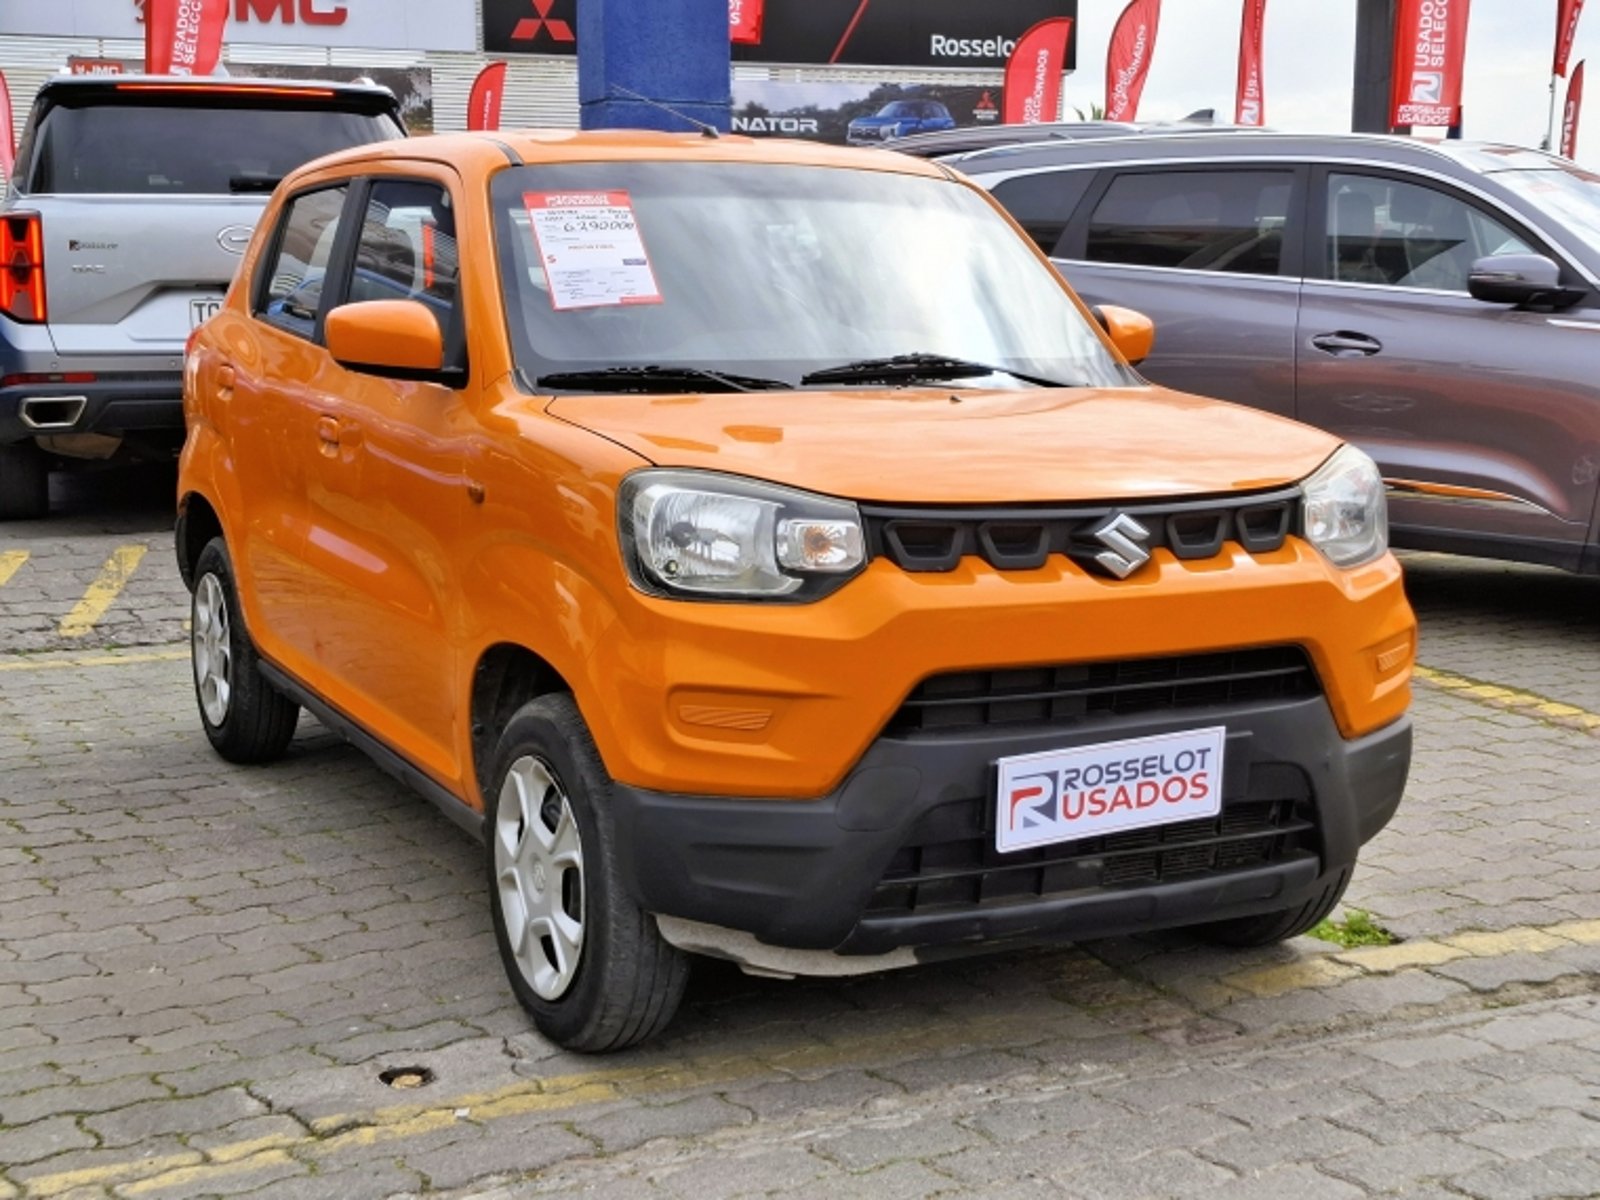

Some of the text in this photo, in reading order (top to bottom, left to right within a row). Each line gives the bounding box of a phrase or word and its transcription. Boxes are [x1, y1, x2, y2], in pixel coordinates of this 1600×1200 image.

[172, 0, 191, 63] USADO
[183, 0, 203, 64] SELECC
[930, 34, 1016, 58] Rosselo
[1414, 0, 1434, 66] USADO
[1396, 113, 1450, 125] USADOS
[1063, 747, 1211, 791] ROSSELOT
[1063, 772, 1209, 820] USADOS
